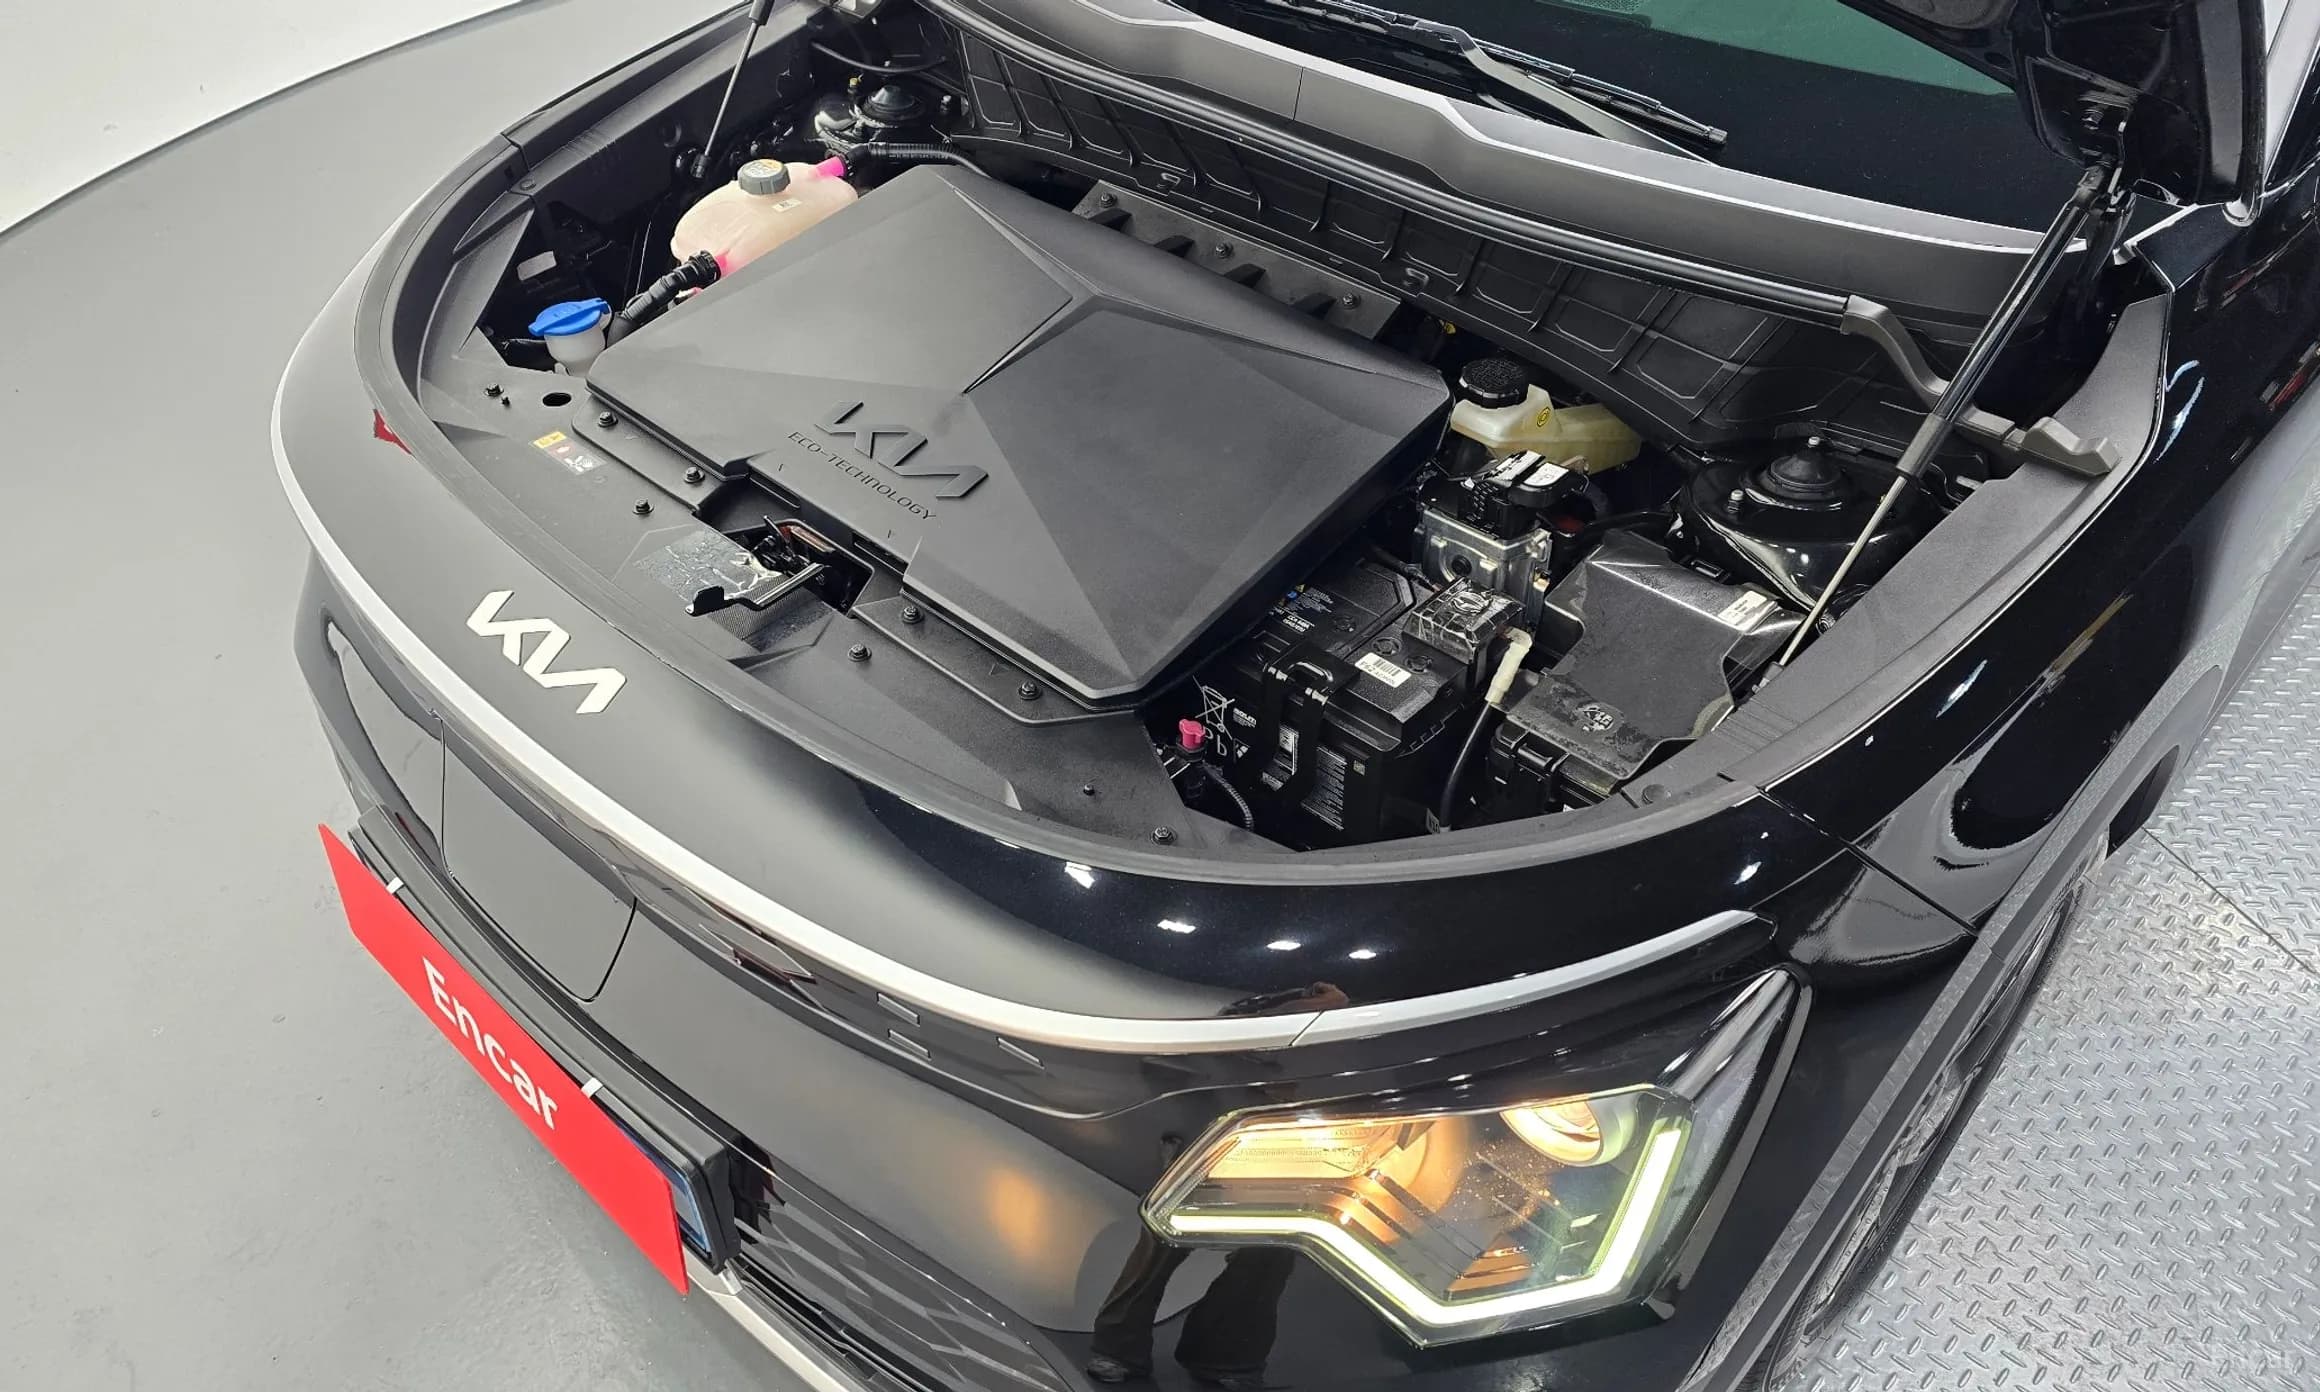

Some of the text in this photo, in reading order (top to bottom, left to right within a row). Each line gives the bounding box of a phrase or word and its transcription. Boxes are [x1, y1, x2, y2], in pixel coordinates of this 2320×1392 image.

[787, 430, 937, 522] ECO-TECHNOLOGY
[815, 400, 989, 500] KIA
[466, 589, 627, 715] KIA
[422, 956, 559, 1131] Encar
